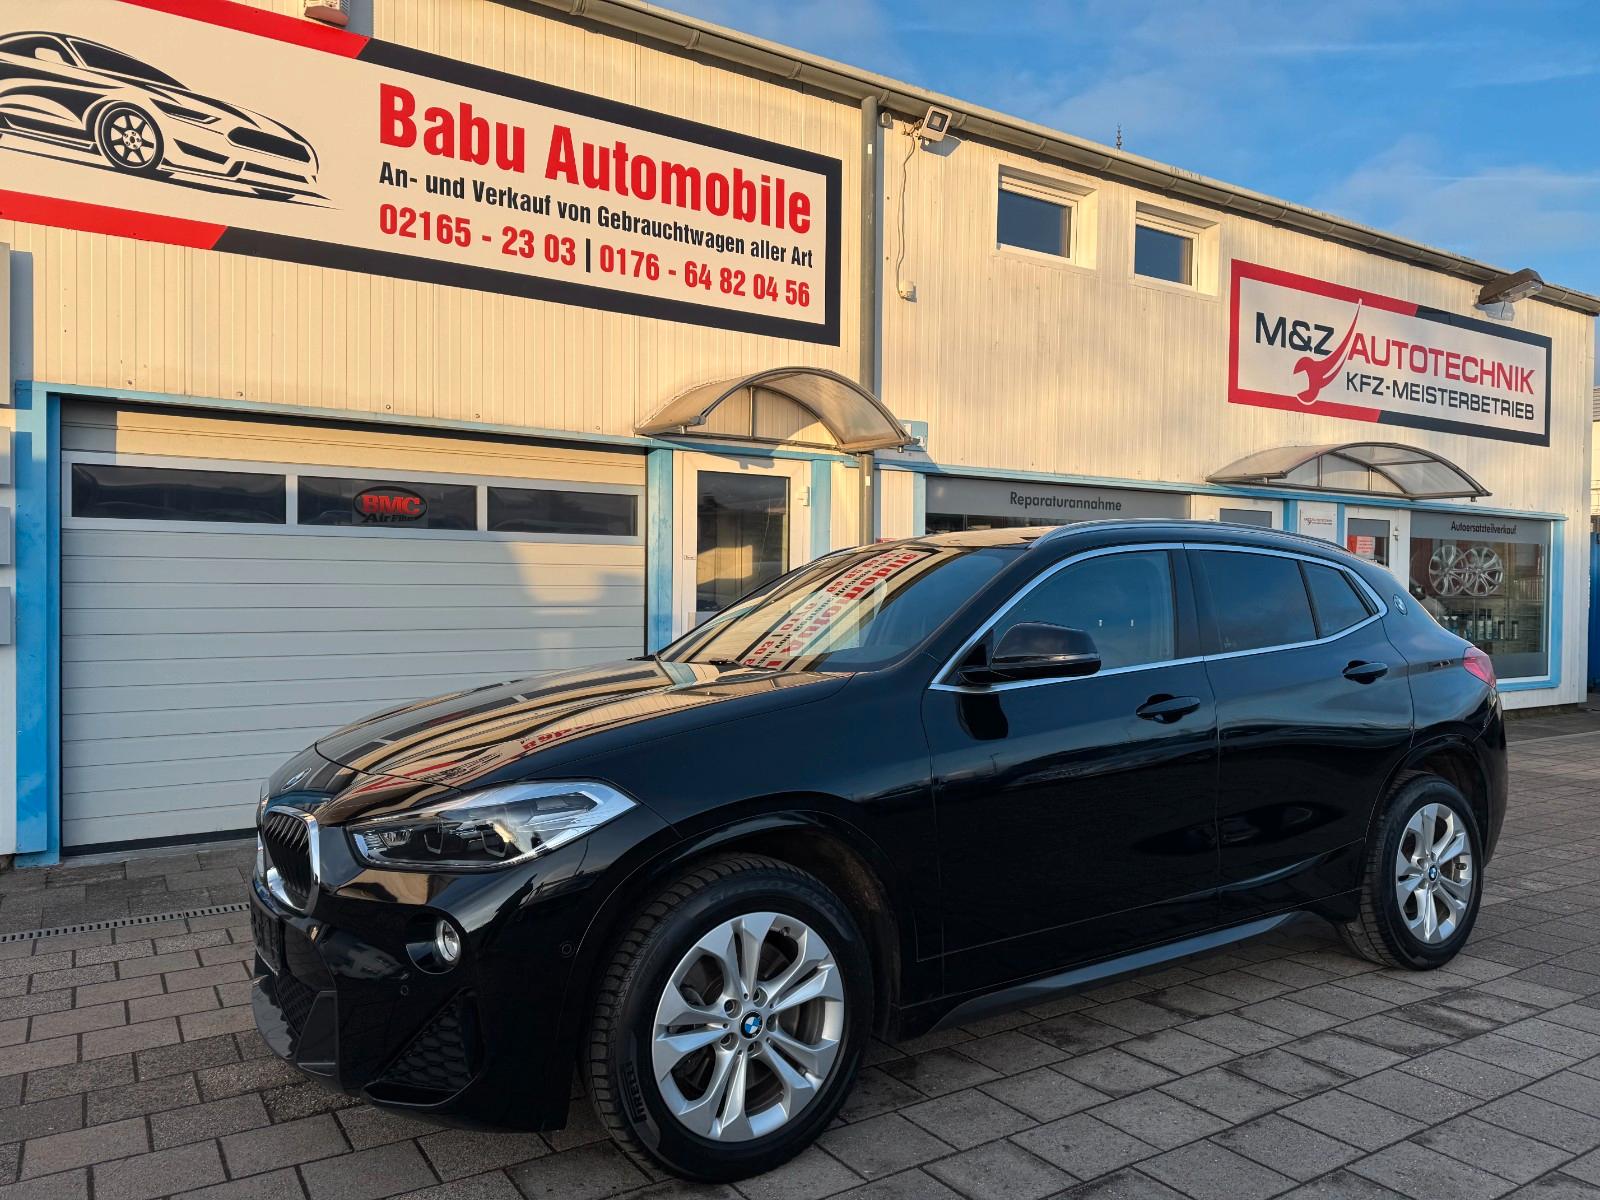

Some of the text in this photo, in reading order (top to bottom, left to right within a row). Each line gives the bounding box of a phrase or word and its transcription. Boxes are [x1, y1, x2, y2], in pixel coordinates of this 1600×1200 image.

[379, 82, 811, 234] Babu Automobile
[379, 161, 813, 268] An- und Verkauf von Gebrauchtwagen aller Art
[379, 203, 471, 248] 02165
[501, 225, 535, 259] 23
[544, 233, 576, 266] 03
[599, 244, 660, 281] 0176
[684, 260, 712, 291] 64
[719, 267, 746, 297] 82
[753, 273, 779, 302] 04
[785, 279, 810, 308] 56
[1255, 311, 1536, 395] M&Z AUTOTECHNIK
[1346, 371, 1535, 421] KFZ-MEISTERBETRIEB
[362, 495, 420, 514] BMC
[1009, 491, 1122, 512] Reparaturannahme
[1450, 520, 1518, 535] Autoersatzteilverkauf
